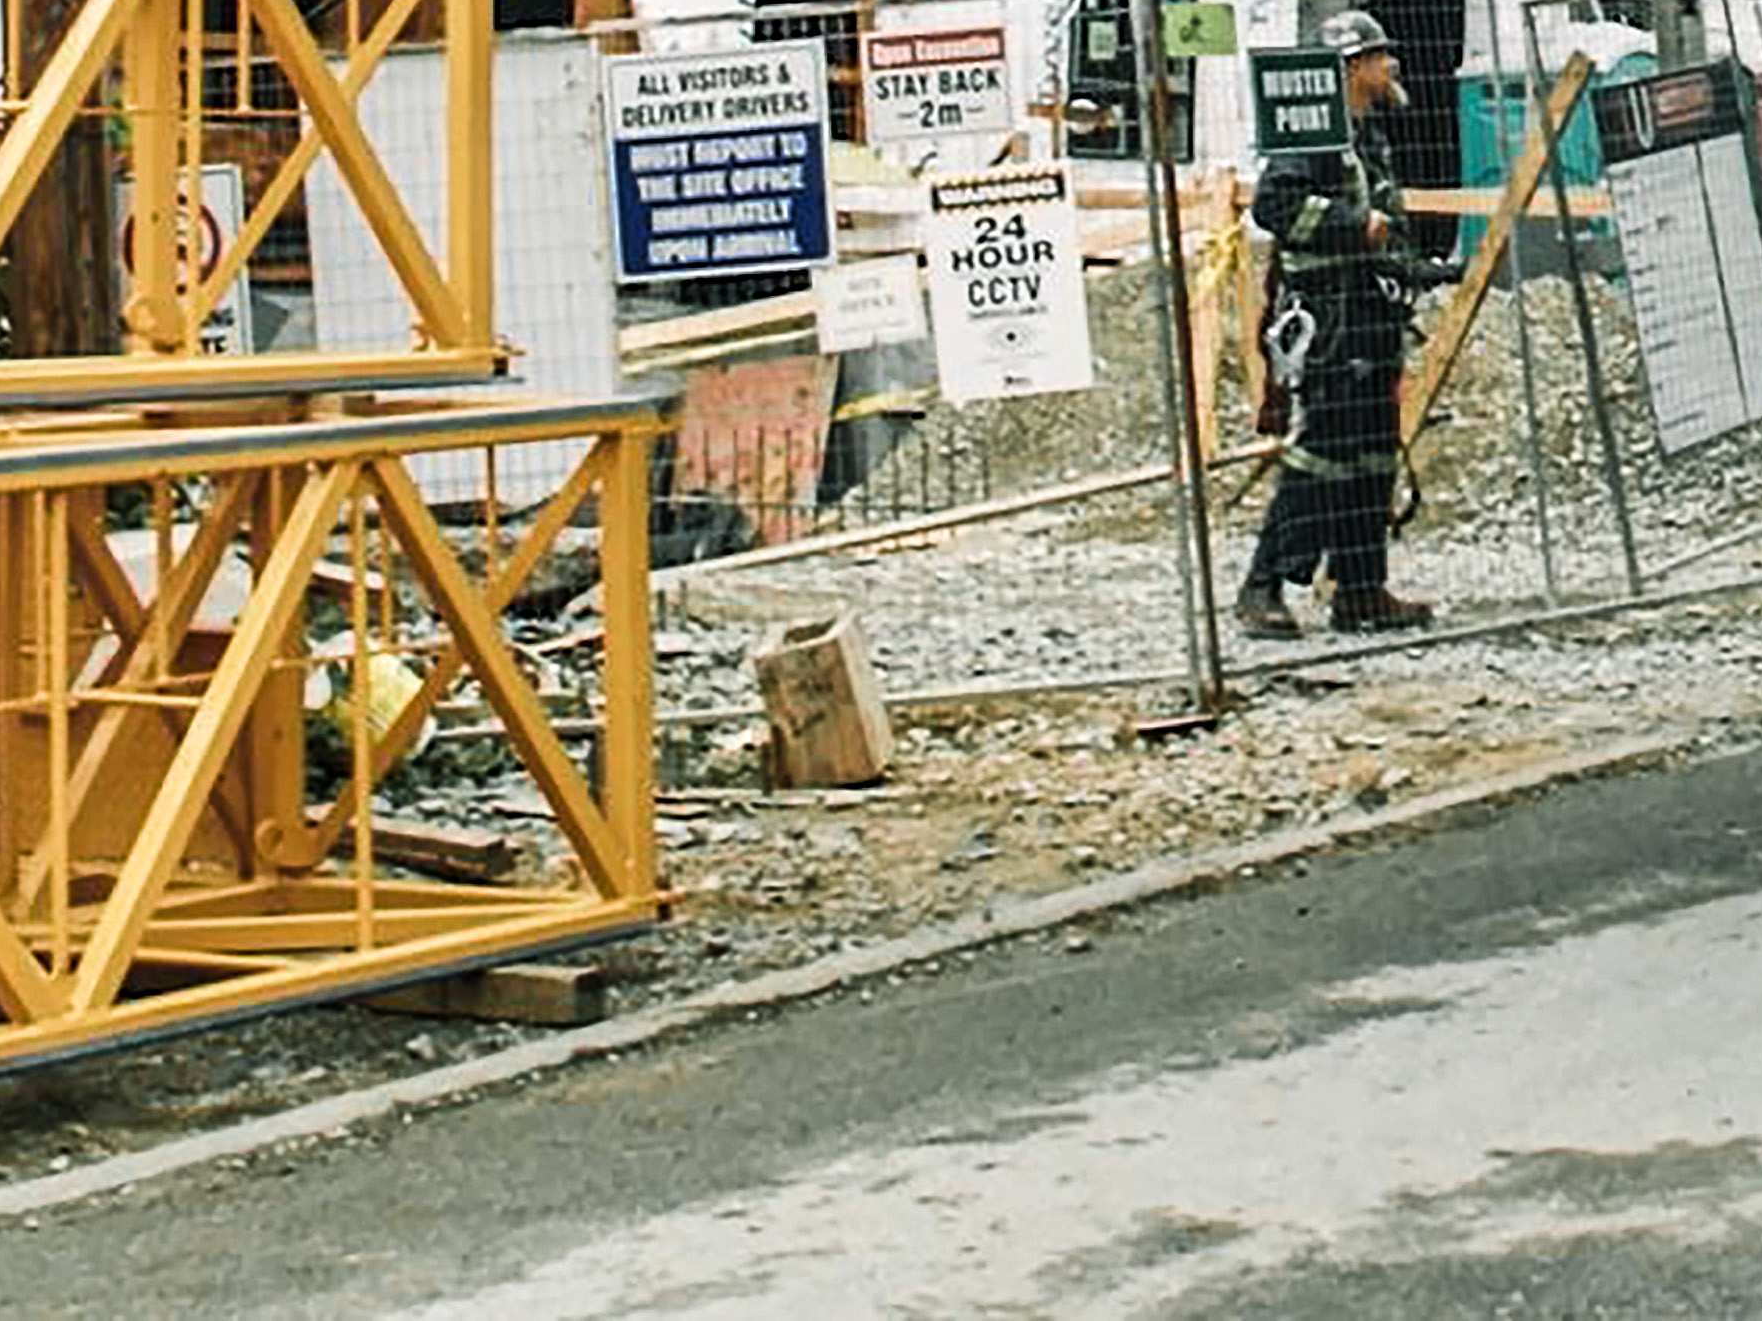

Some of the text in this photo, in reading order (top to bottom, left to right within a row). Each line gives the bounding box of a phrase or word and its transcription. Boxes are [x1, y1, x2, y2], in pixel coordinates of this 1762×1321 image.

[639, 62, 791, 96] ALL VISITORS &
[875, 67, 1002, 101] STAY BACK
[622, 91, 810, 129] DELIVERY DRIVERS
[937, 177, 1058, 206] WARNING
[974, 213, 1027, 245] 24
[950, 240, 1056, 273] HOUR
[967, 275, 1042, 308] CCTV
